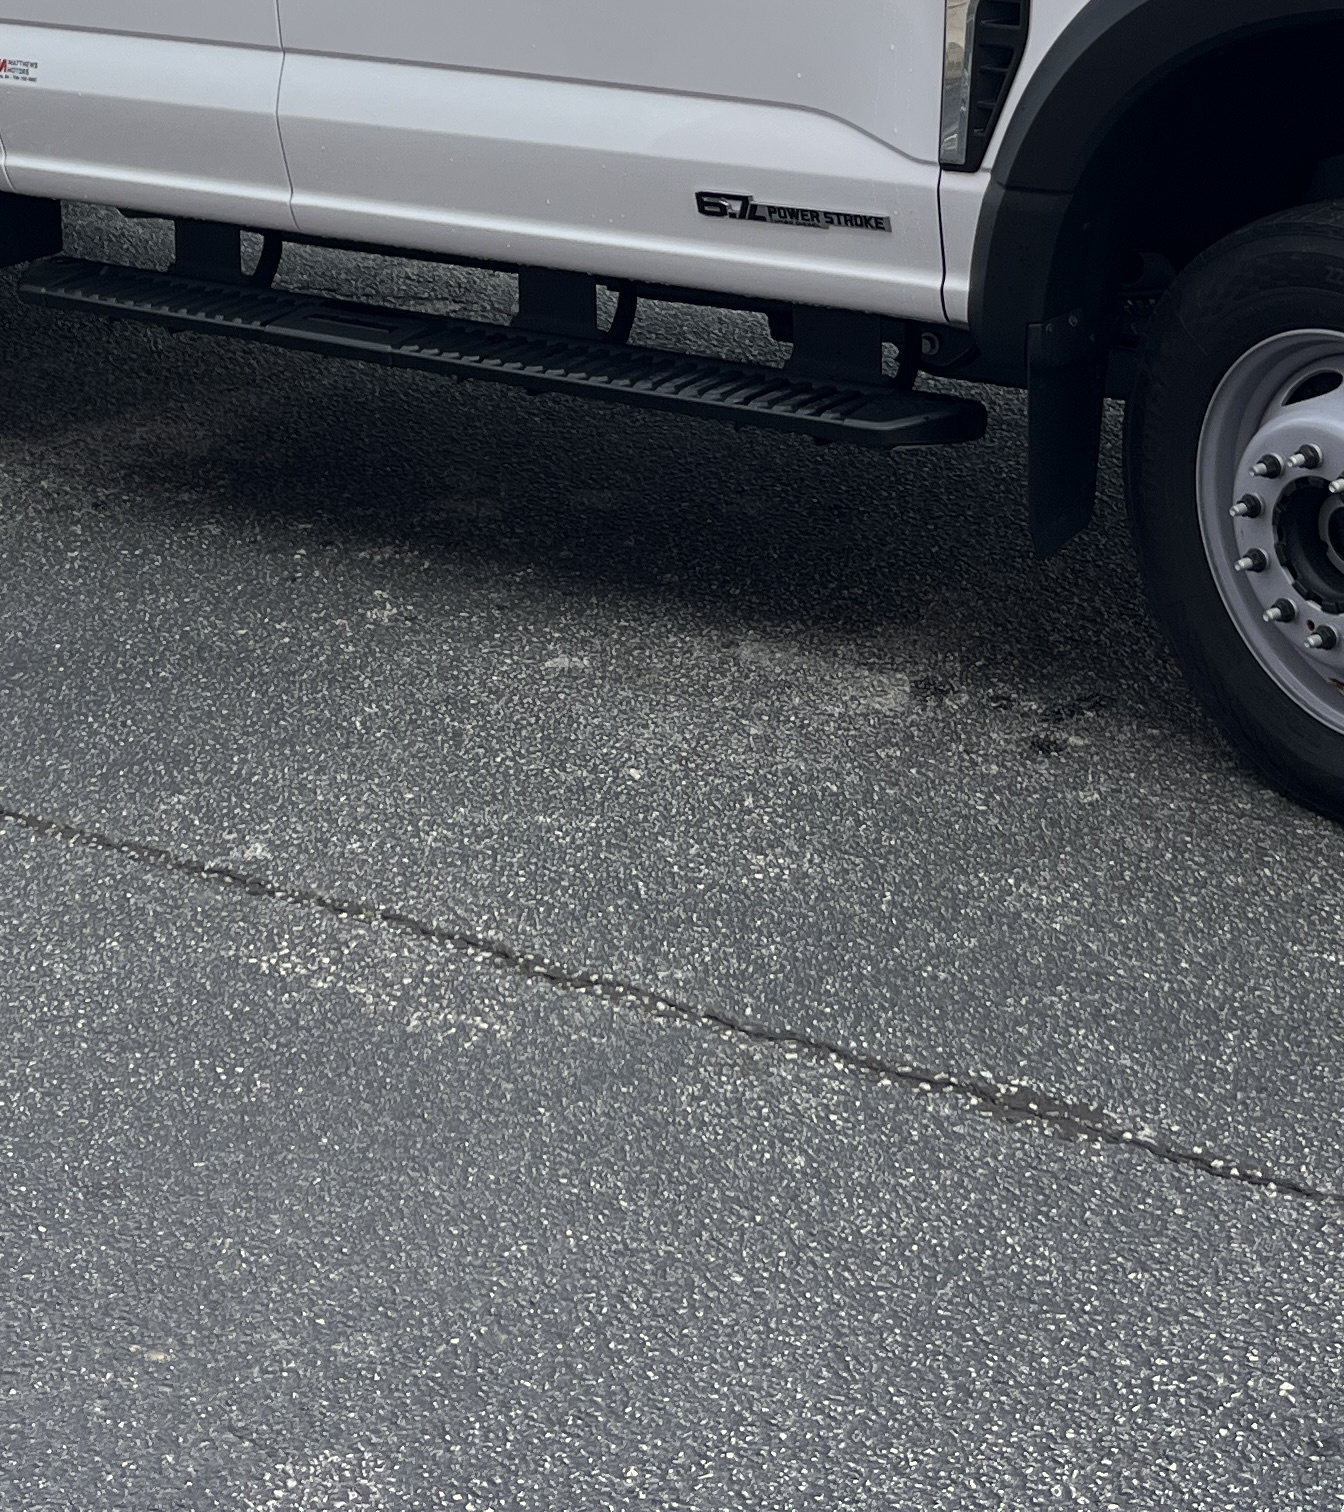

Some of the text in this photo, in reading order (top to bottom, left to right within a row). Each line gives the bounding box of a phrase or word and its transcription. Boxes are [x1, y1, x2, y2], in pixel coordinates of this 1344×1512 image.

[695, 191, 768, 222] 6.7L
[766, 205, 821, 224] POWER
[823, 211, 886, 230] STROKE
